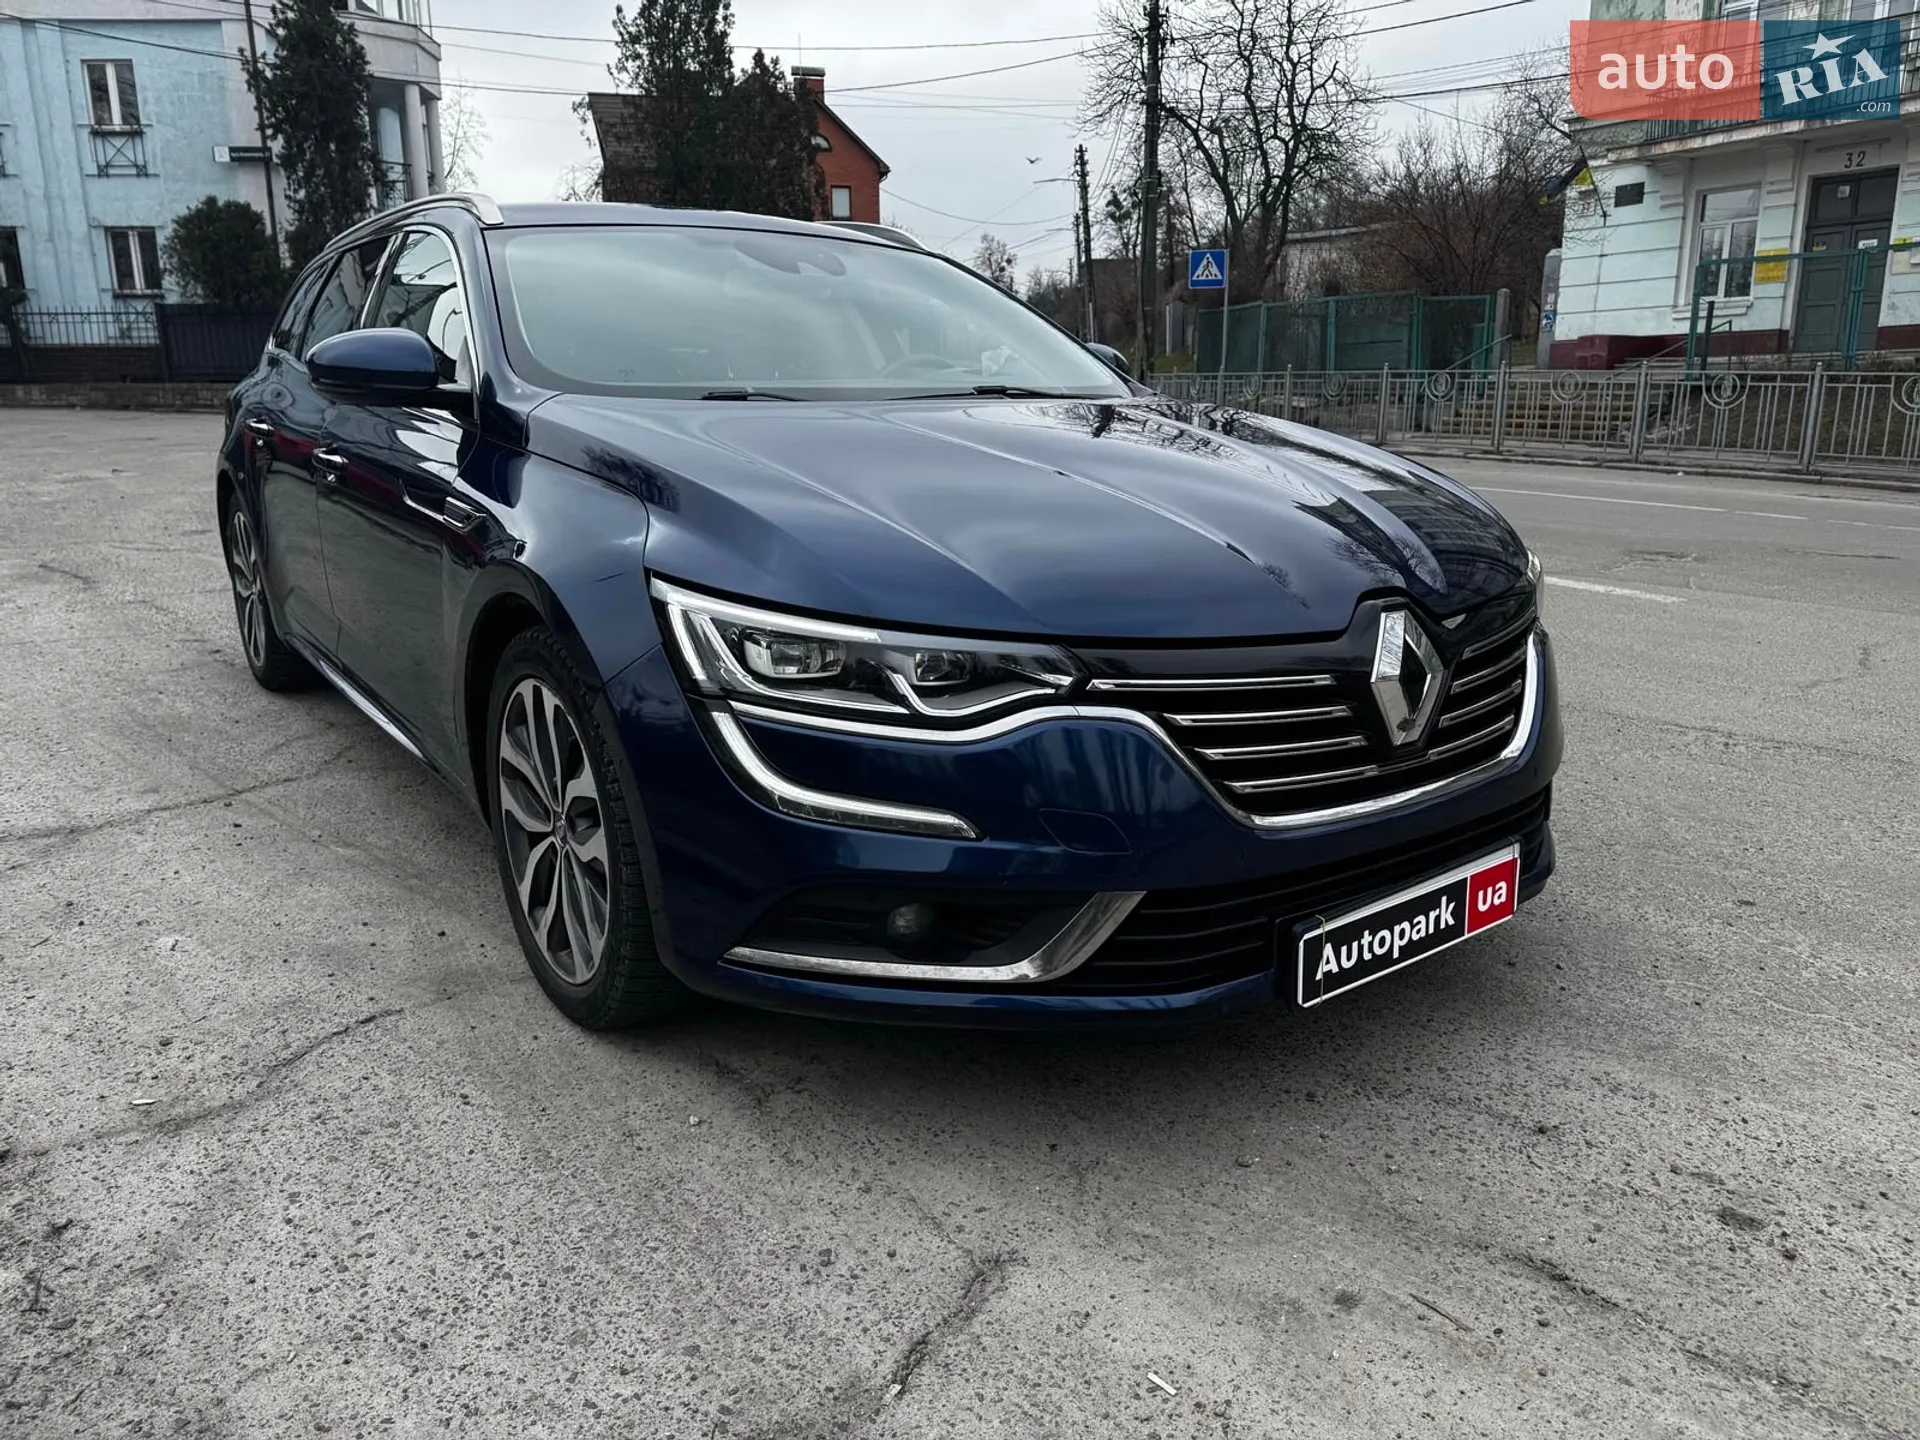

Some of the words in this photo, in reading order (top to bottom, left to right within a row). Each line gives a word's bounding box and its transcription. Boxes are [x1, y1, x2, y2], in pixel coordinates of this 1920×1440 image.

[1844, 150, 1867, 169] 32
[1315, 895, 1456, 981] Autopark
[1477, 880, 1508, 912] ua
